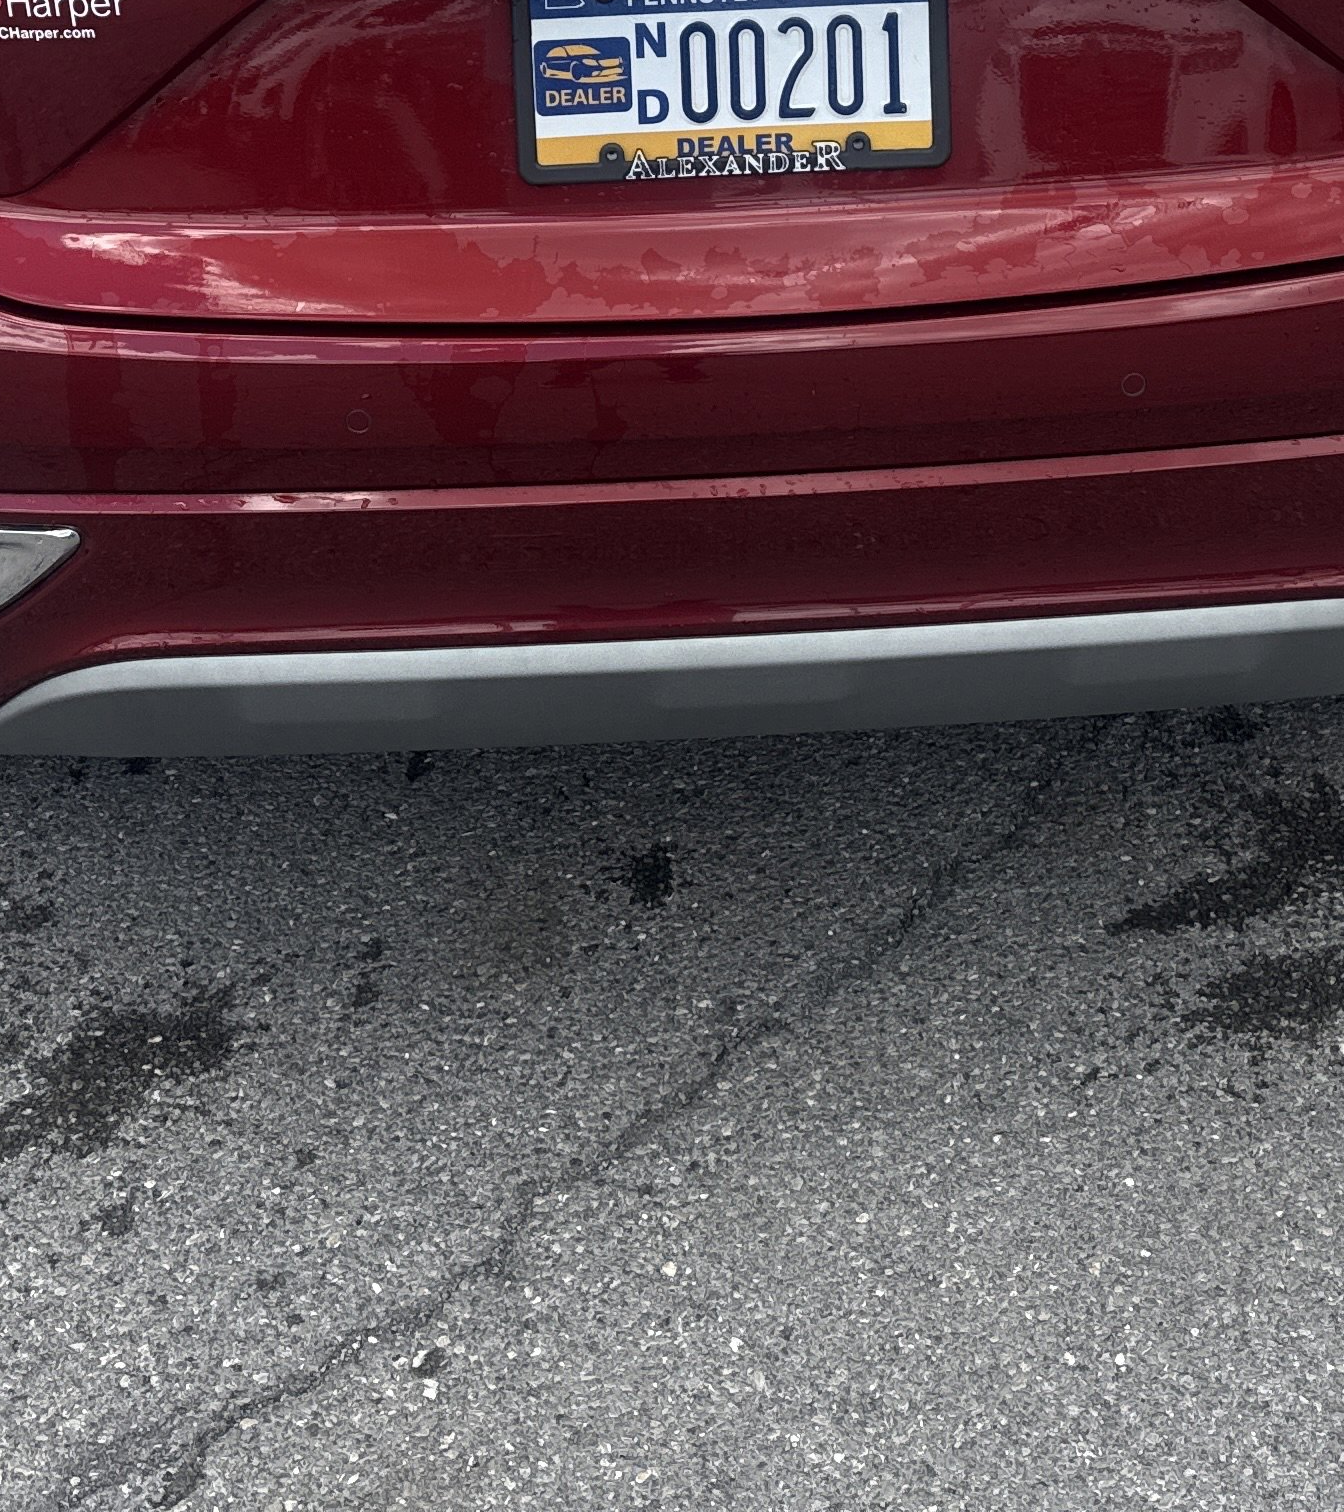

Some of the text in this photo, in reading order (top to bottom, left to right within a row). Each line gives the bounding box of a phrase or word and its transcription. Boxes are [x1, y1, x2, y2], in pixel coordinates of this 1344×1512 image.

[634, 21, 667, 59] N
[679, 11, 909, 124] 00201
[545, 86, 626, 108] DEALER
[637, 89, 670, 125] D
[625, 140, 847, 181] ALEXANDER
[676, 132, 794, 158] DEALER
